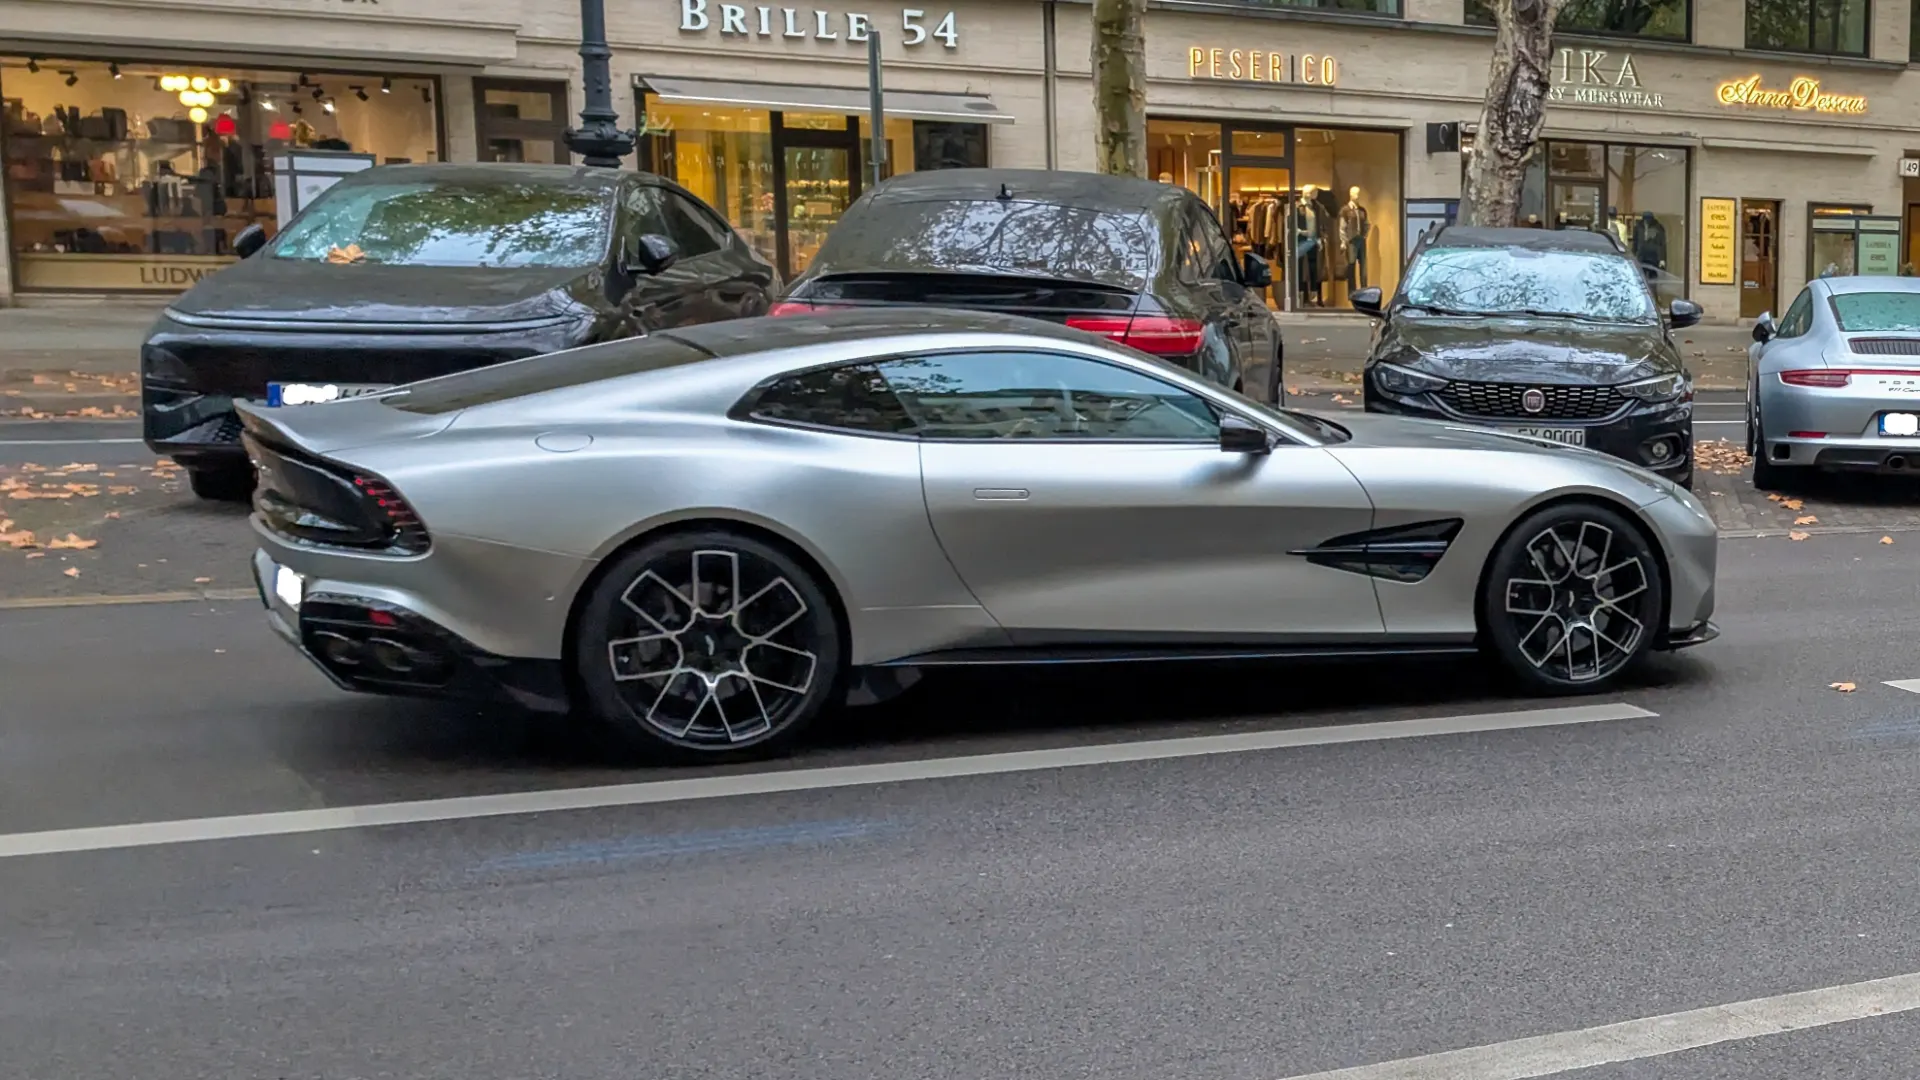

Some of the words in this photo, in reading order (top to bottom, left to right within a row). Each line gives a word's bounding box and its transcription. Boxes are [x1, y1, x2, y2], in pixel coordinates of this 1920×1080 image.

[679, 0, 869, 42] BRILLE
[902, 9, 959, 48] 54
[1190, 47, 1336, 85] PESERICO
[1575, 88, 1664, 107] MENSWEAR
[1718, 75, 1791, 108] Anna
[1790, 77, 1868, 113] Dessous
[1907, 162, 1918, 172] 49
